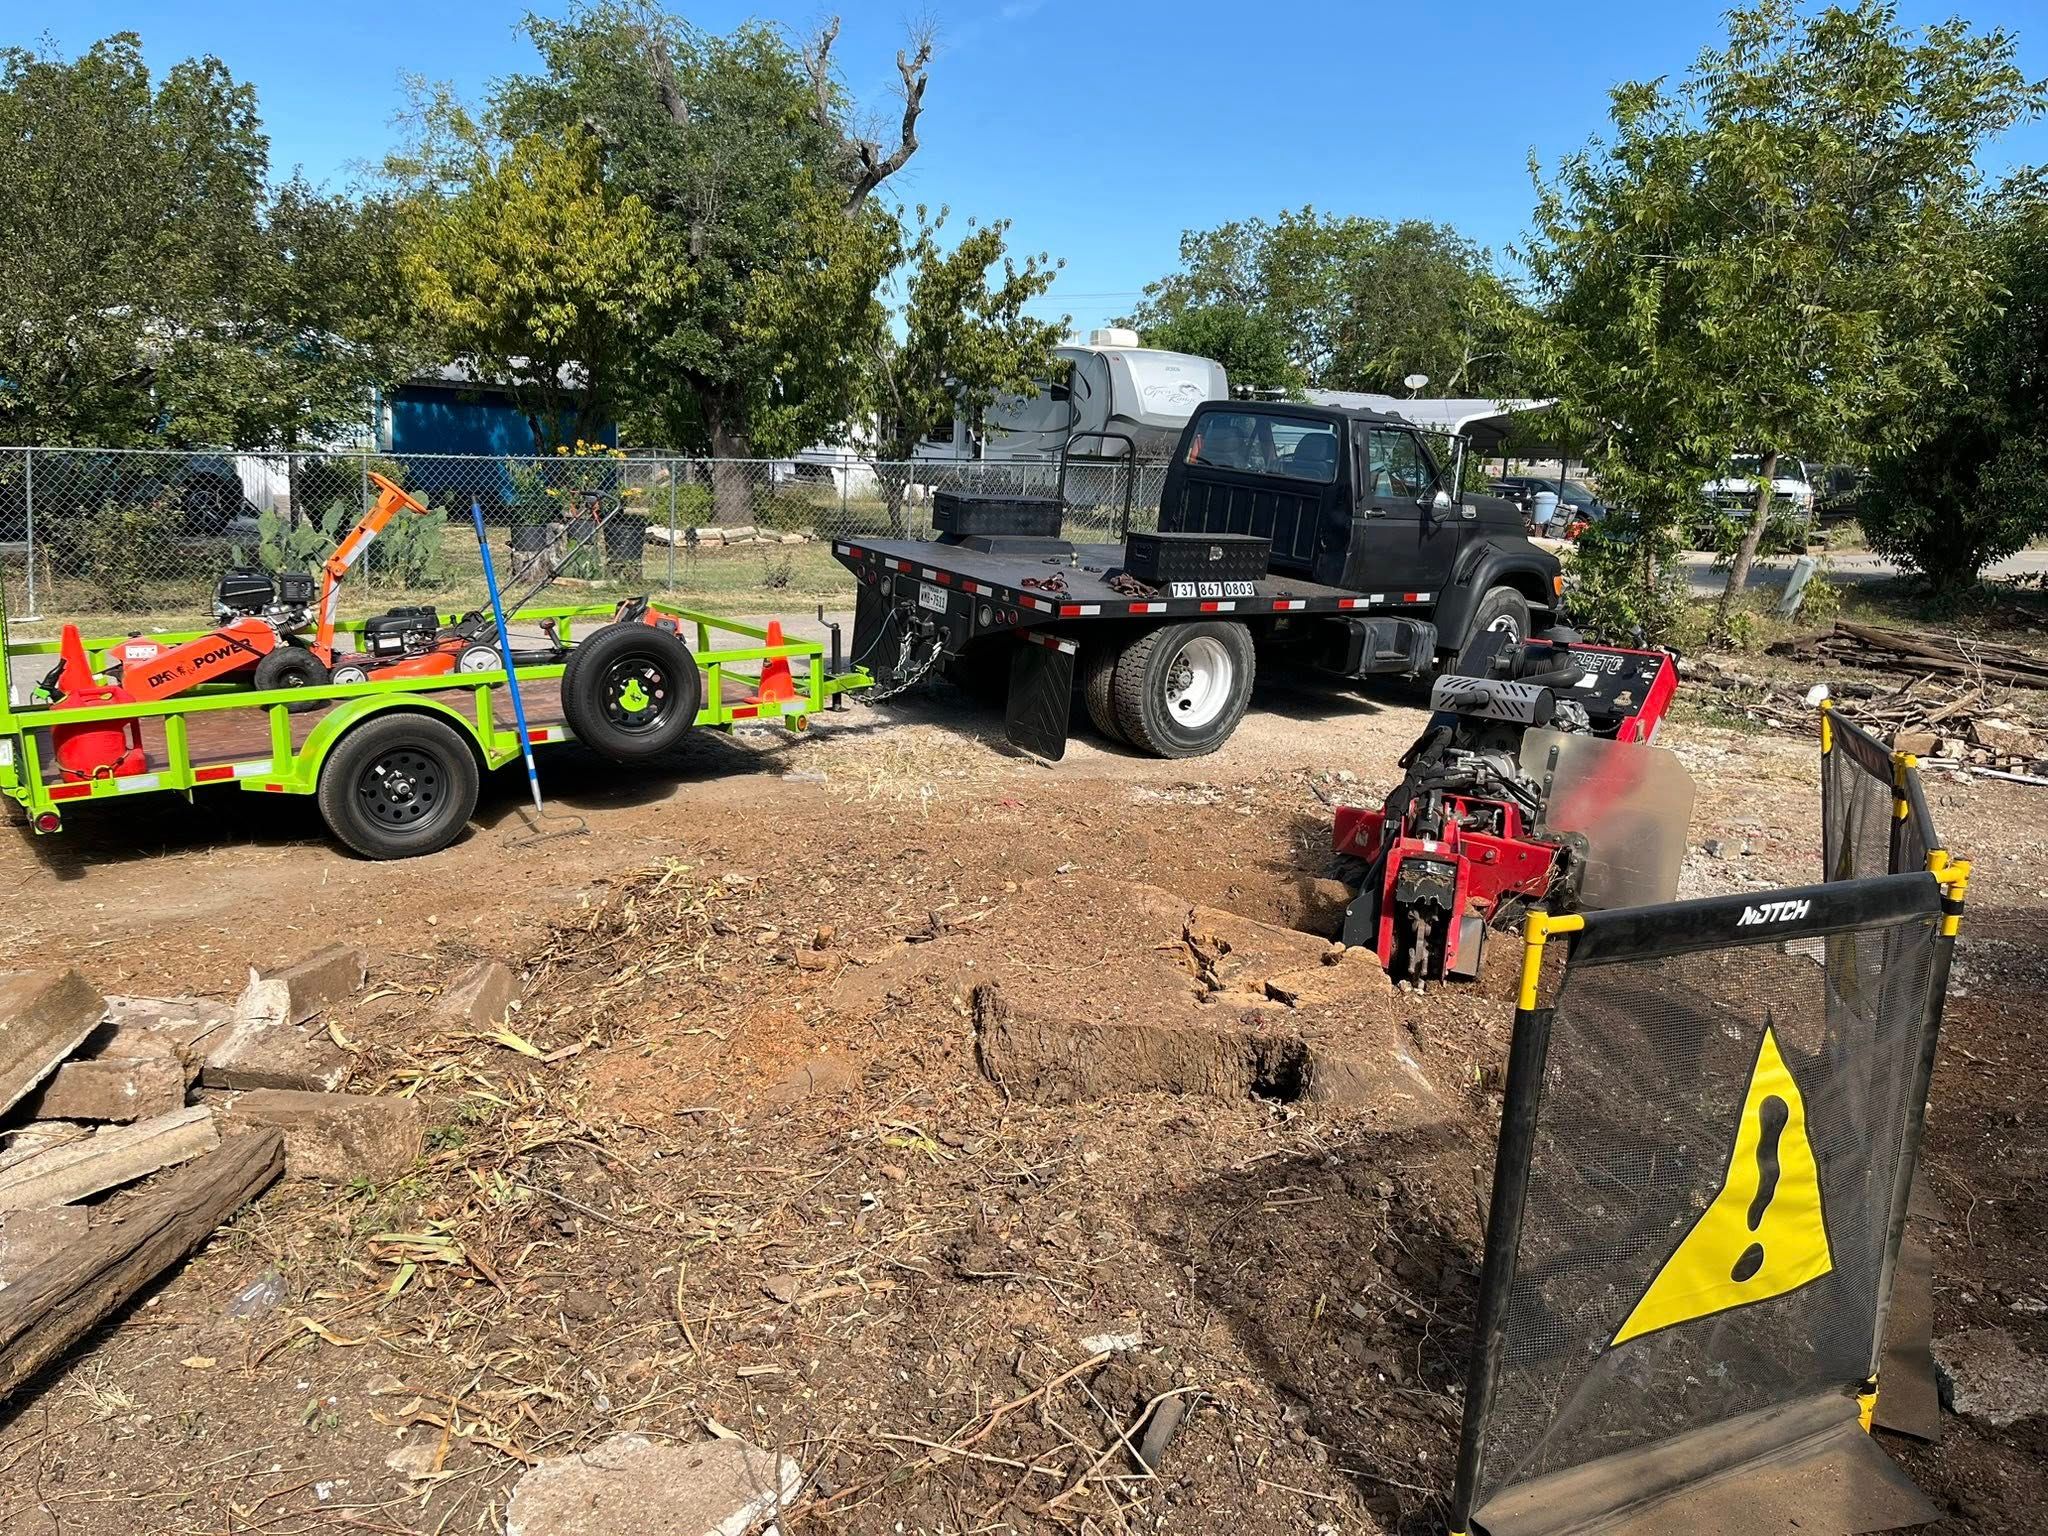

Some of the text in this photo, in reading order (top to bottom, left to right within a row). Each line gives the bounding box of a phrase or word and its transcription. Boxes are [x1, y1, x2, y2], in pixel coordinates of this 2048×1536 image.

[1173, 582, 1254, 596] 737 867 0803
[192, 638, 253, 669] POWER
[1736, 899, 1811, 927] NOTCH
